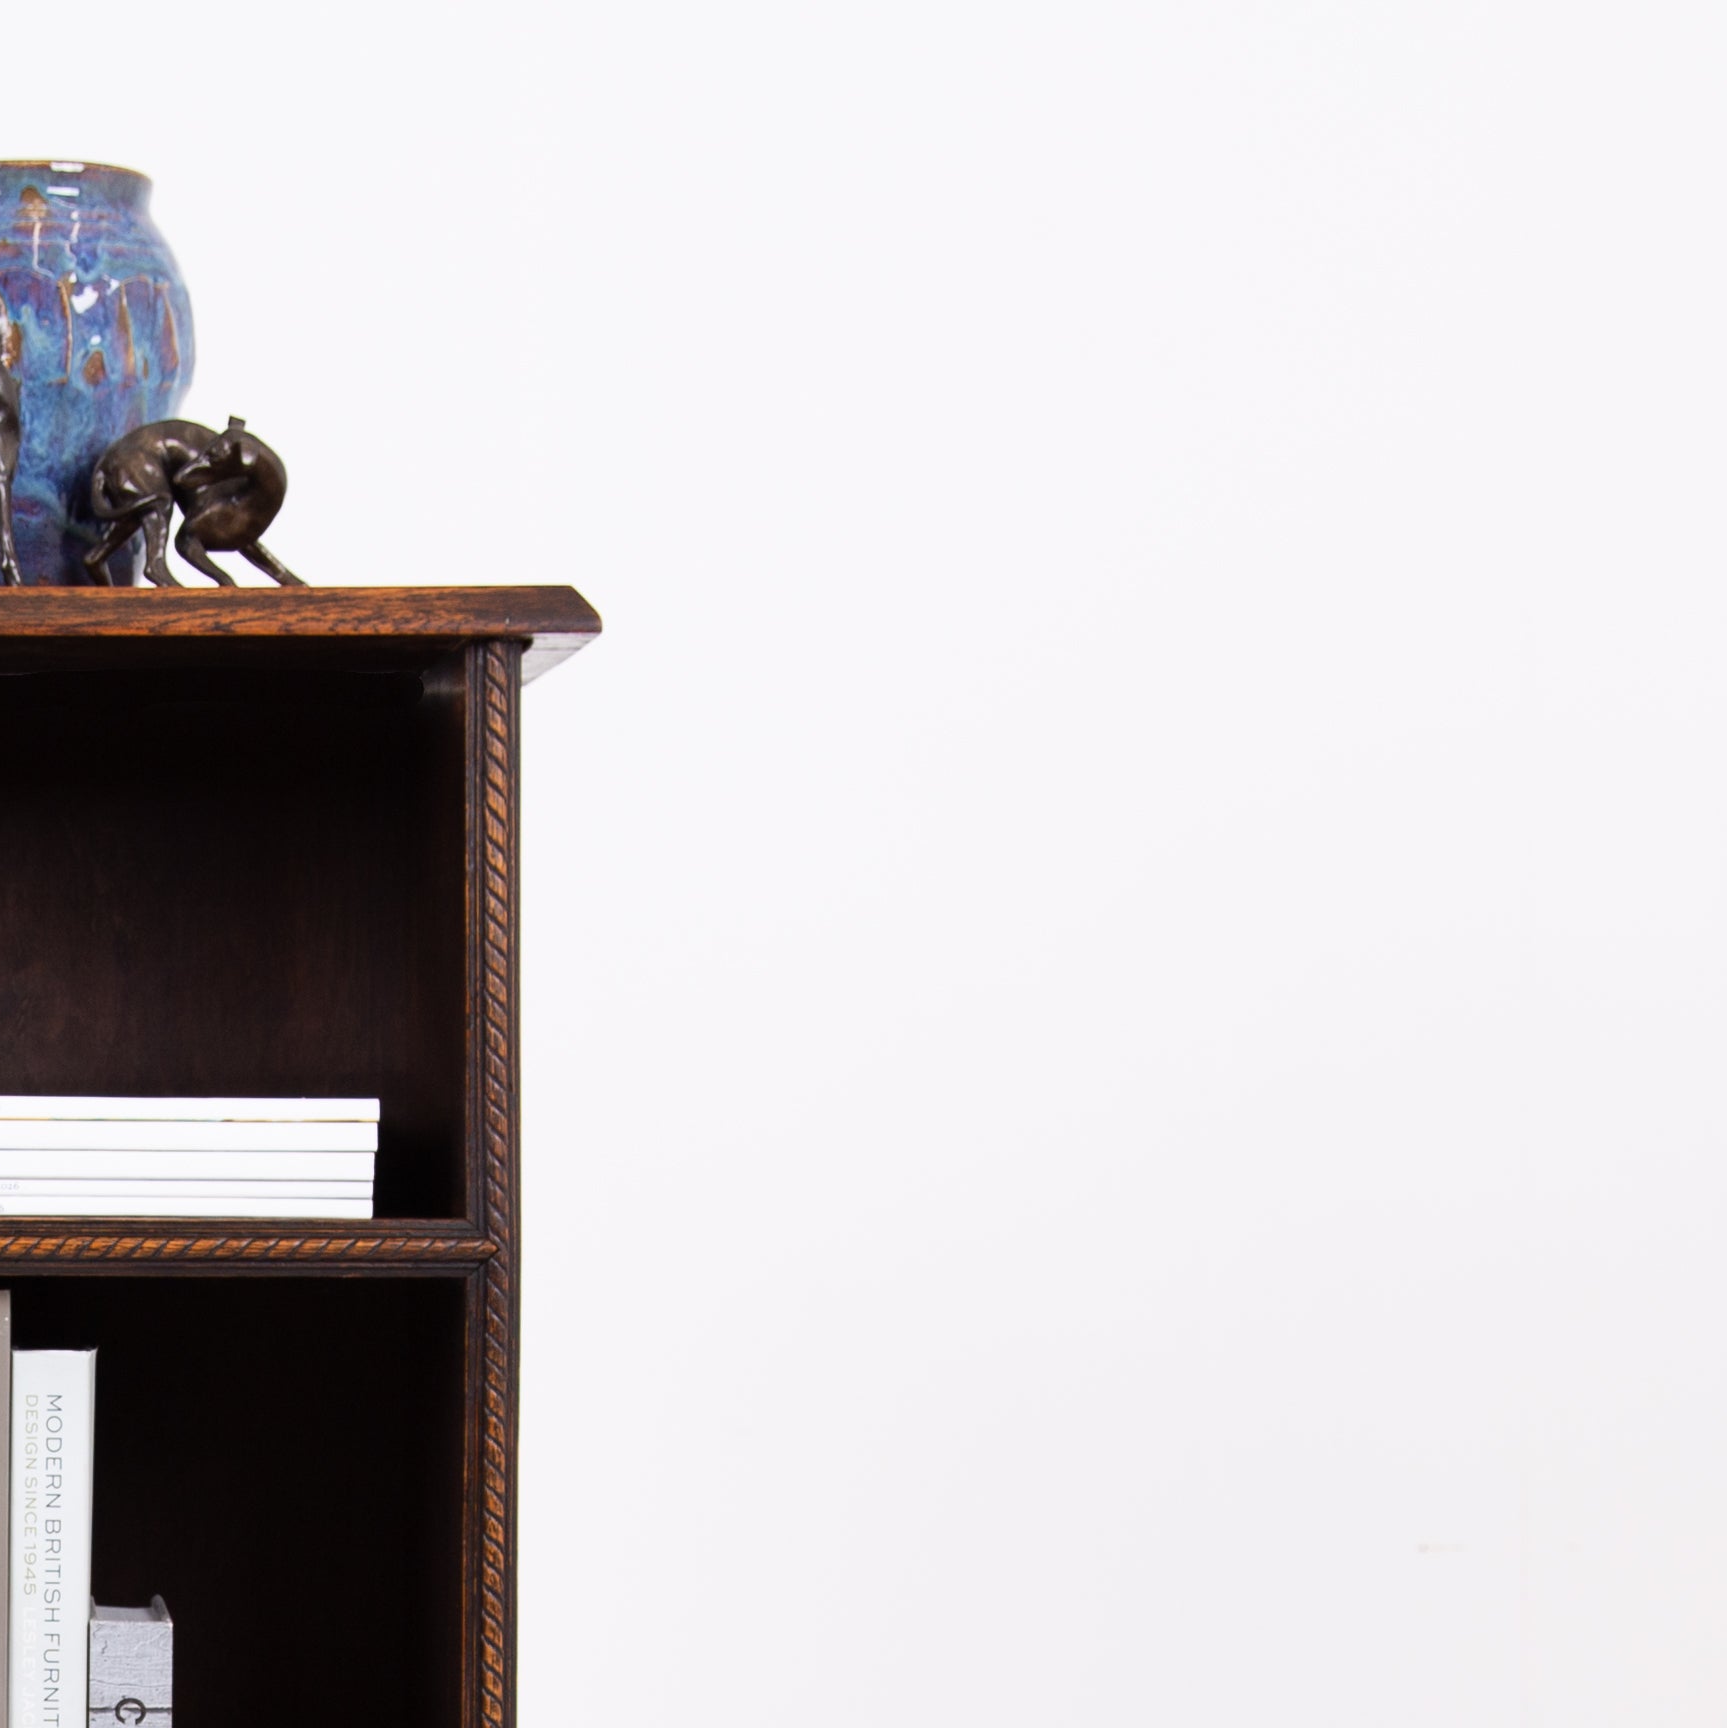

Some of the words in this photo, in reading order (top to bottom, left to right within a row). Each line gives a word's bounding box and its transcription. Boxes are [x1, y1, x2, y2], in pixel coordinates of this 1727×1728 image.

[25, 1395, 39, 1471] DESIGN
[45, 1394, 63, 1510] MODERN
[25, 1477, 38, 1537] SINCE
[24, 1545, 36, 1595] 1945
[44, 1519, 61, 1623] BRITISH
[22, 1607, 36, 1680] LESLEY
